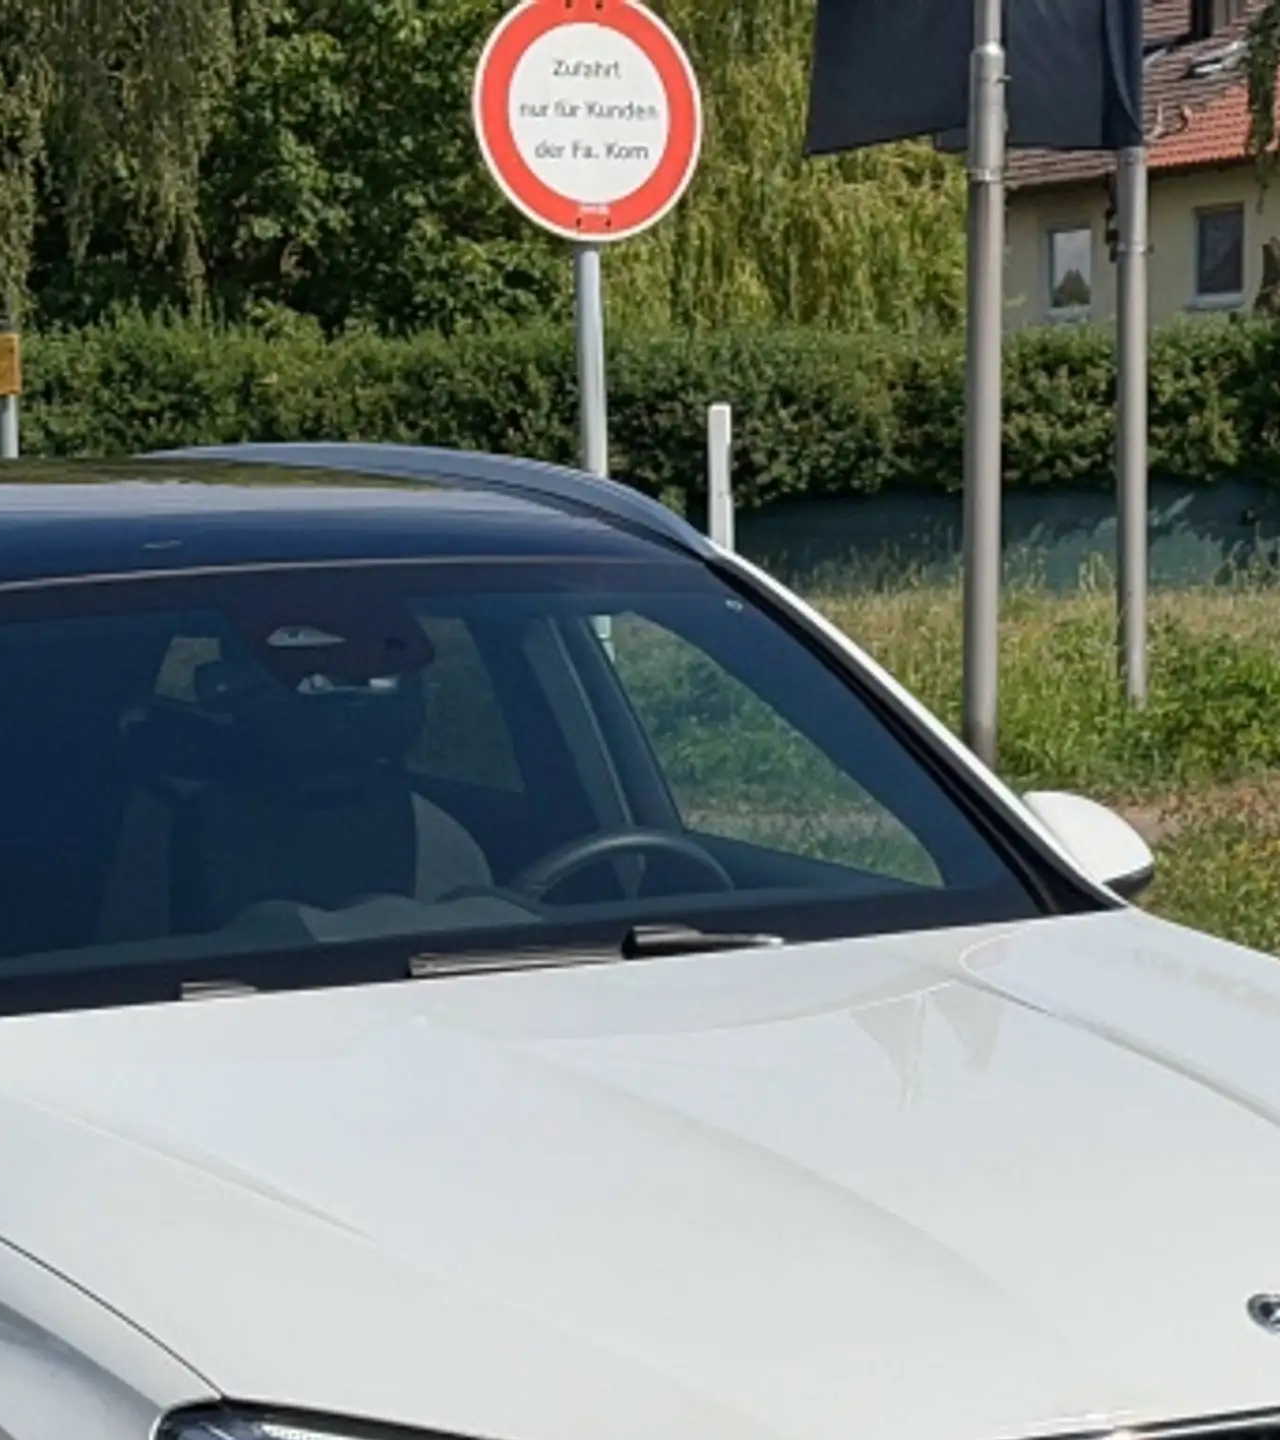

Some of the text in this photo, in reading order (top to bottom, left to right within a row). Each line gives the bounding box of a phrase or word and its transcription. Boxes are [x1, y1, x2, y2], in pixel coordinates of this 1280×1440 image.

[553, 60, 620, 78] Zufahrt
[520, 98, 658, 120] nur für Kunden
[535, 140, 565, 158] der
[572, 140, 600, 158] Fa.
